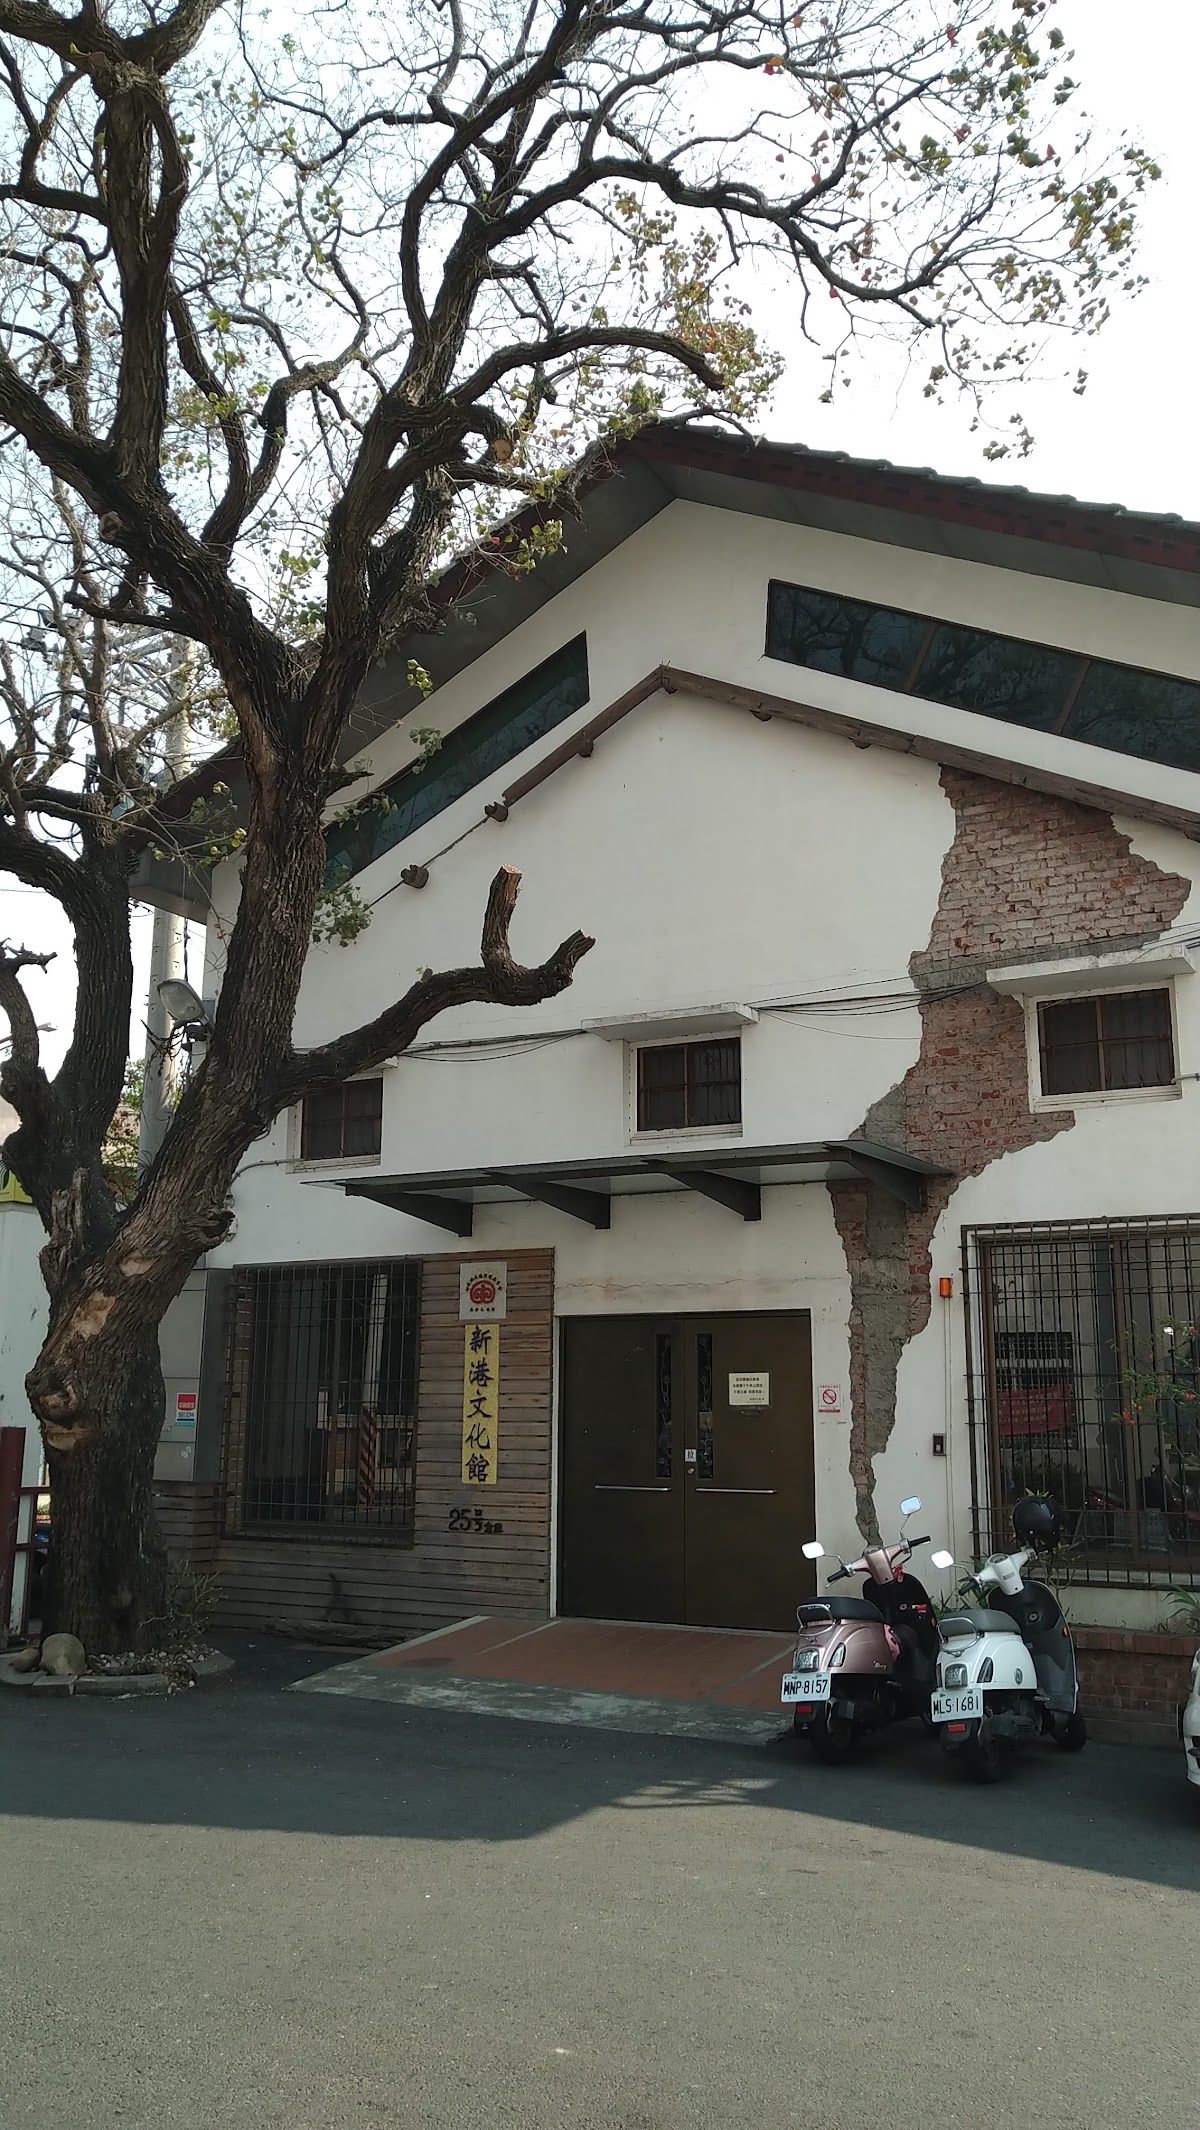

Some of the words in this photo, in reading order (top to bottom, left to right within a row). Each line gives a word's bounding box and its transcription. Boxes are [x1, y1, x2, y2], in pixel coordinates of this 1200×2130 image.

[464, 1325, 494, 1483] 新港文化館
